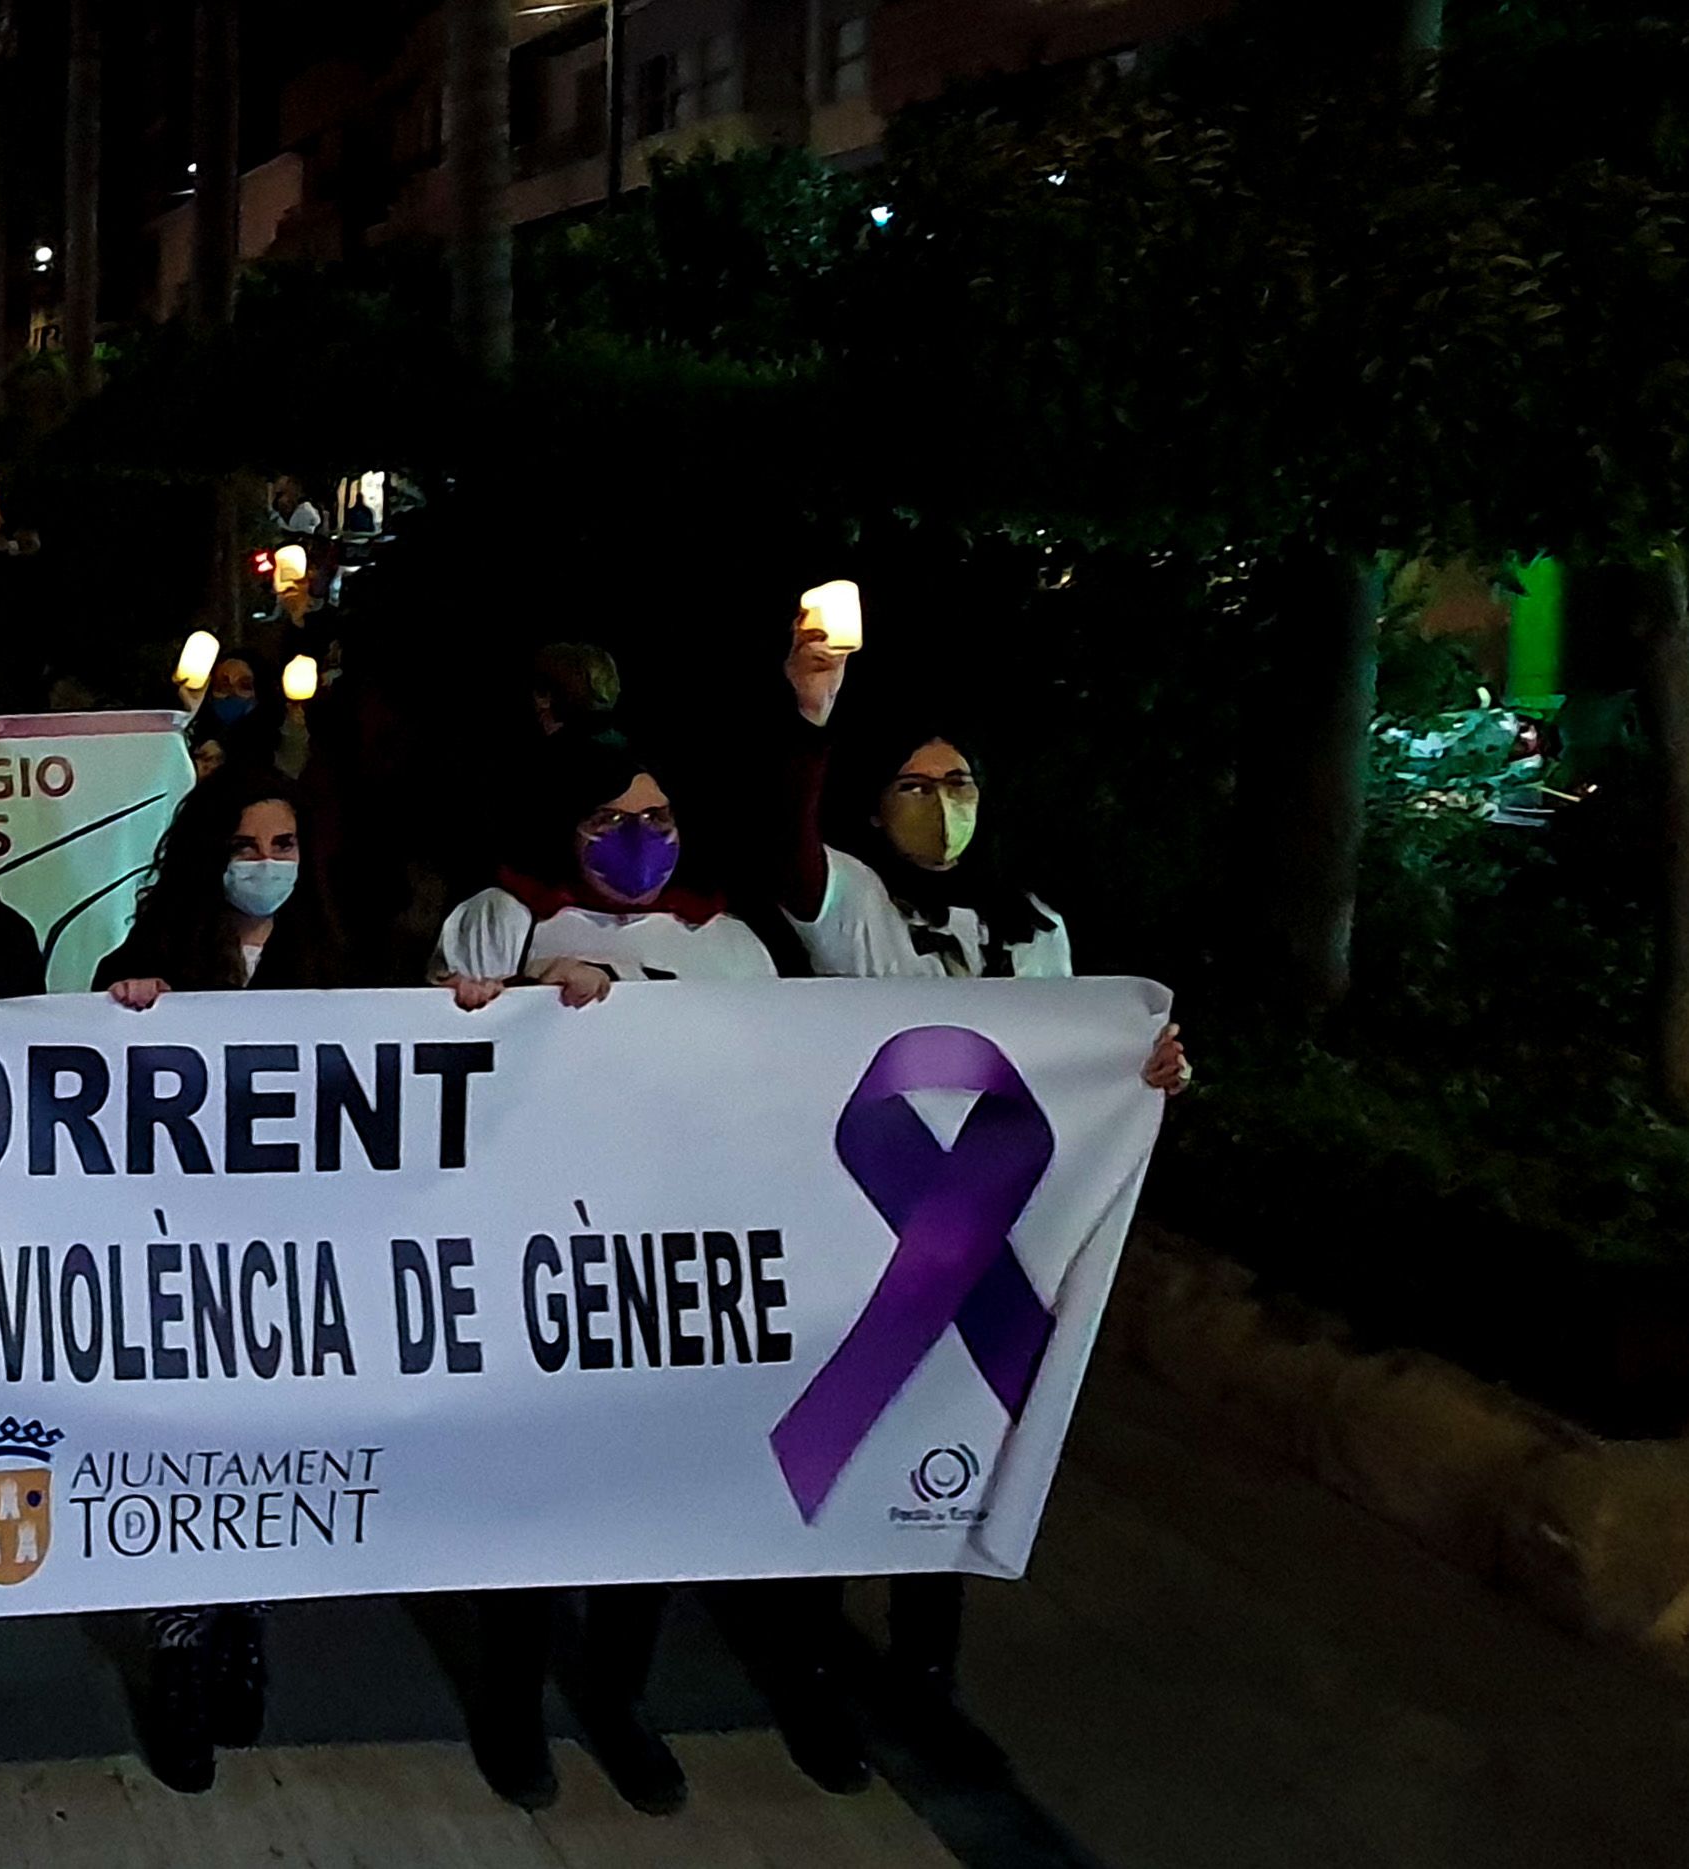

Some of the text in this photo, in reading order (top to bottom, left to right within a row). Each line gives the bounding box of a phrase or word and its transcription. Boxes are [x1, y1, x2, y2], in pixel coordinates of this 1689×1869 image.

[390, 1237, 483, 1375] DE
[522, 1199, 794, 1373] GÈNERE
[71, 1446, 385, 1492] AJUNTAMENT
[68, 1487, 381, 1558] TORRENT
